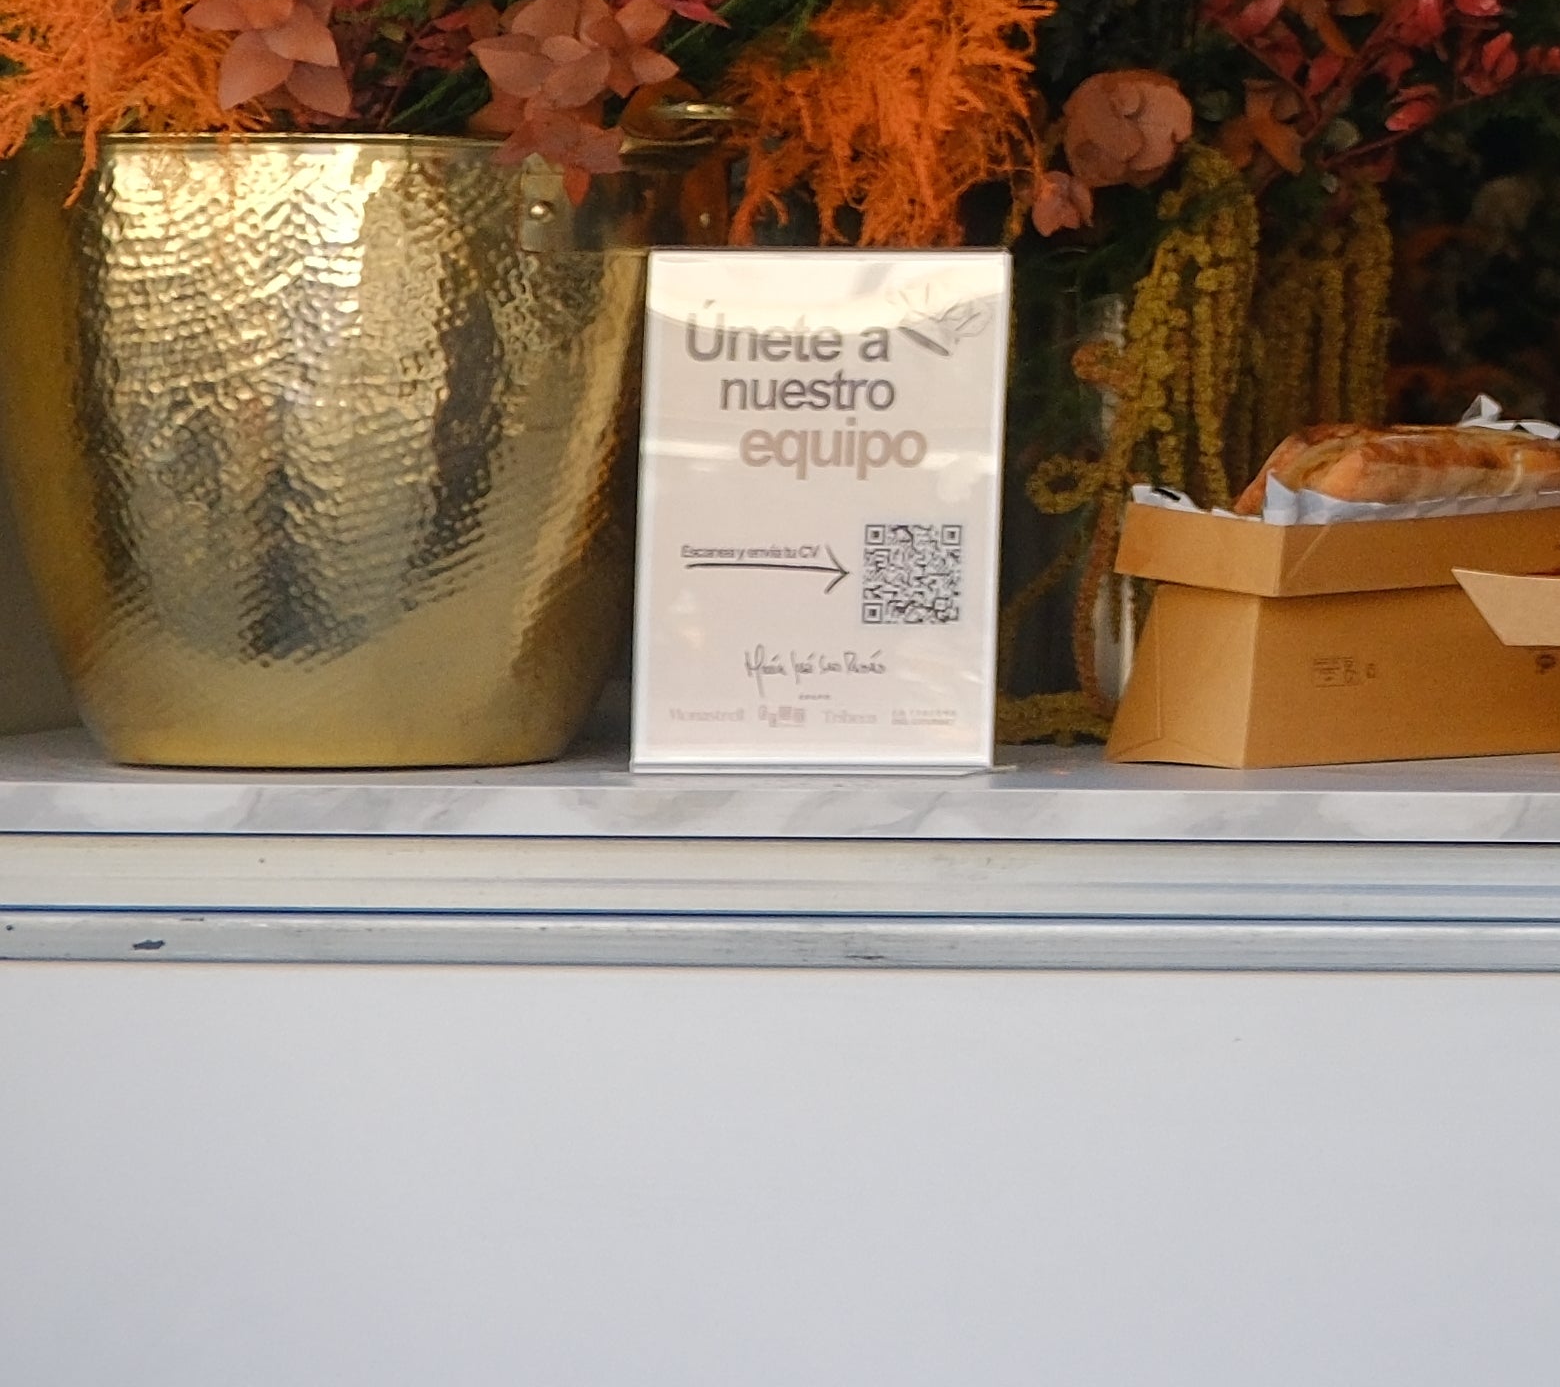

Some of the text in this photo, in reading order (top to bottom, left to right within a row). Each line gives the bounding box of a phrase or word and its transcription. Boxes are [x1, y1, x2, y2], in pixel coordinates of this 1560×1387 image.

[685, 297, 892, 364] Únete a
[719, 369, 896, 412] nuestro
[739, 417, 929, 480] equipo
